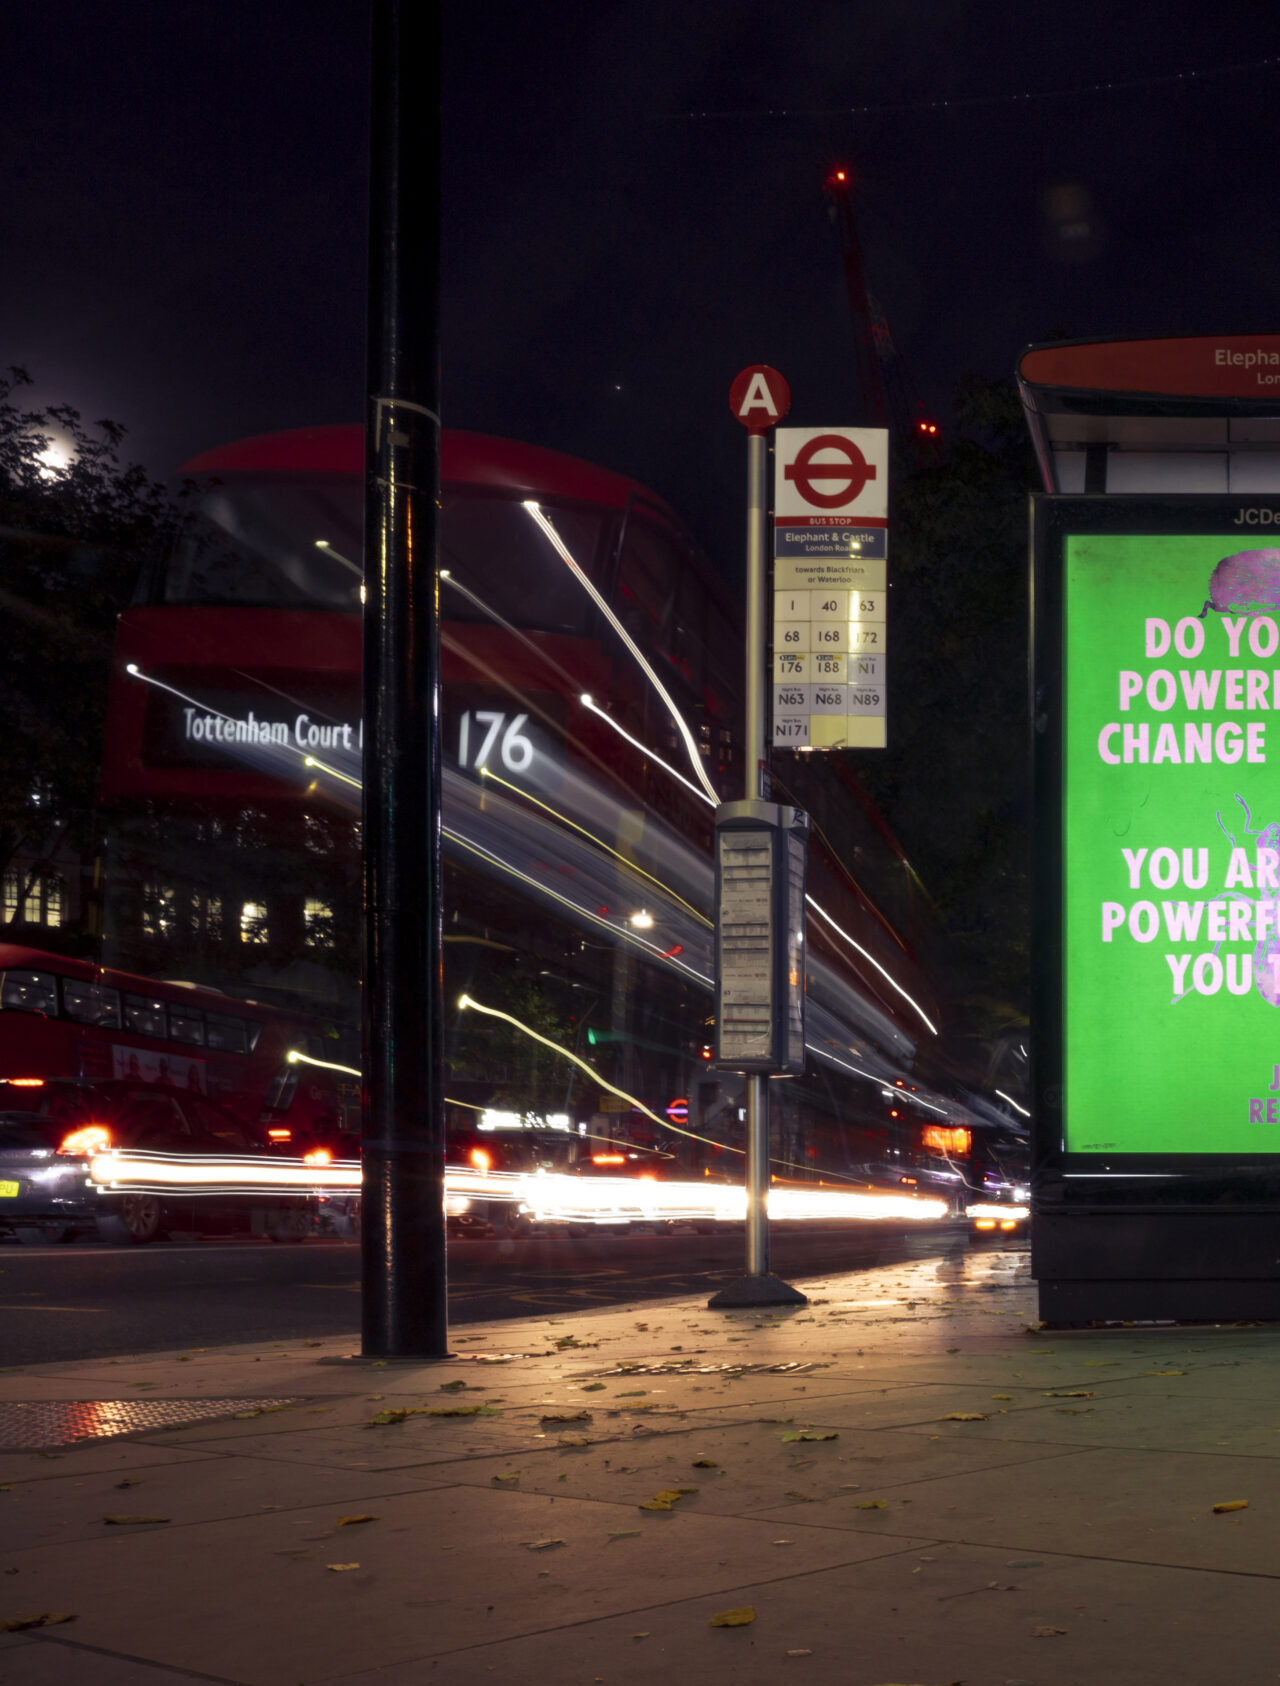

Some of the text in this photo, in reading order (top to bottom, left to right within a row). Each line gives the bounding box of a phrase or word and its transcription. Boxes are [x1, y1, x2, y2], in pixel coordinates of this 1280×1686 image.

[738, 373, 778, 416] A
[785, 532, 875, 544] Elephant & Castle
[835, 544, 857, 552] Roa
[795, 566, 865, 574] towards Blackfriars
[791, 600, 795, 611] 1
[821, 600, 838, 612] 40
[859, 601, 875, 612] 63
[784, 631, 800, 642] 68
[818, 631, 840, 642] 168
[1145, 617, 1205, 658] DO
[781, 662, 803, 673] 176
[818, 662, 840, 673] 188
[858, 663, 875, 675] N1
[778, 694, 804, 705] N63
[815, 694, 842, 705] N68
[853, 694, 880, 706] N89
[183, 708, 289, 745] Tottenham
[295, 714, 353, 750] Court
[776, 725, 808, 737] N171
[458, 710, 534, 773] 176
[1098, 721, 1266, 764] CHANGE
[1121, 846, 1209, 889] YOU
[1164, 953, 1252, 995] YOU
